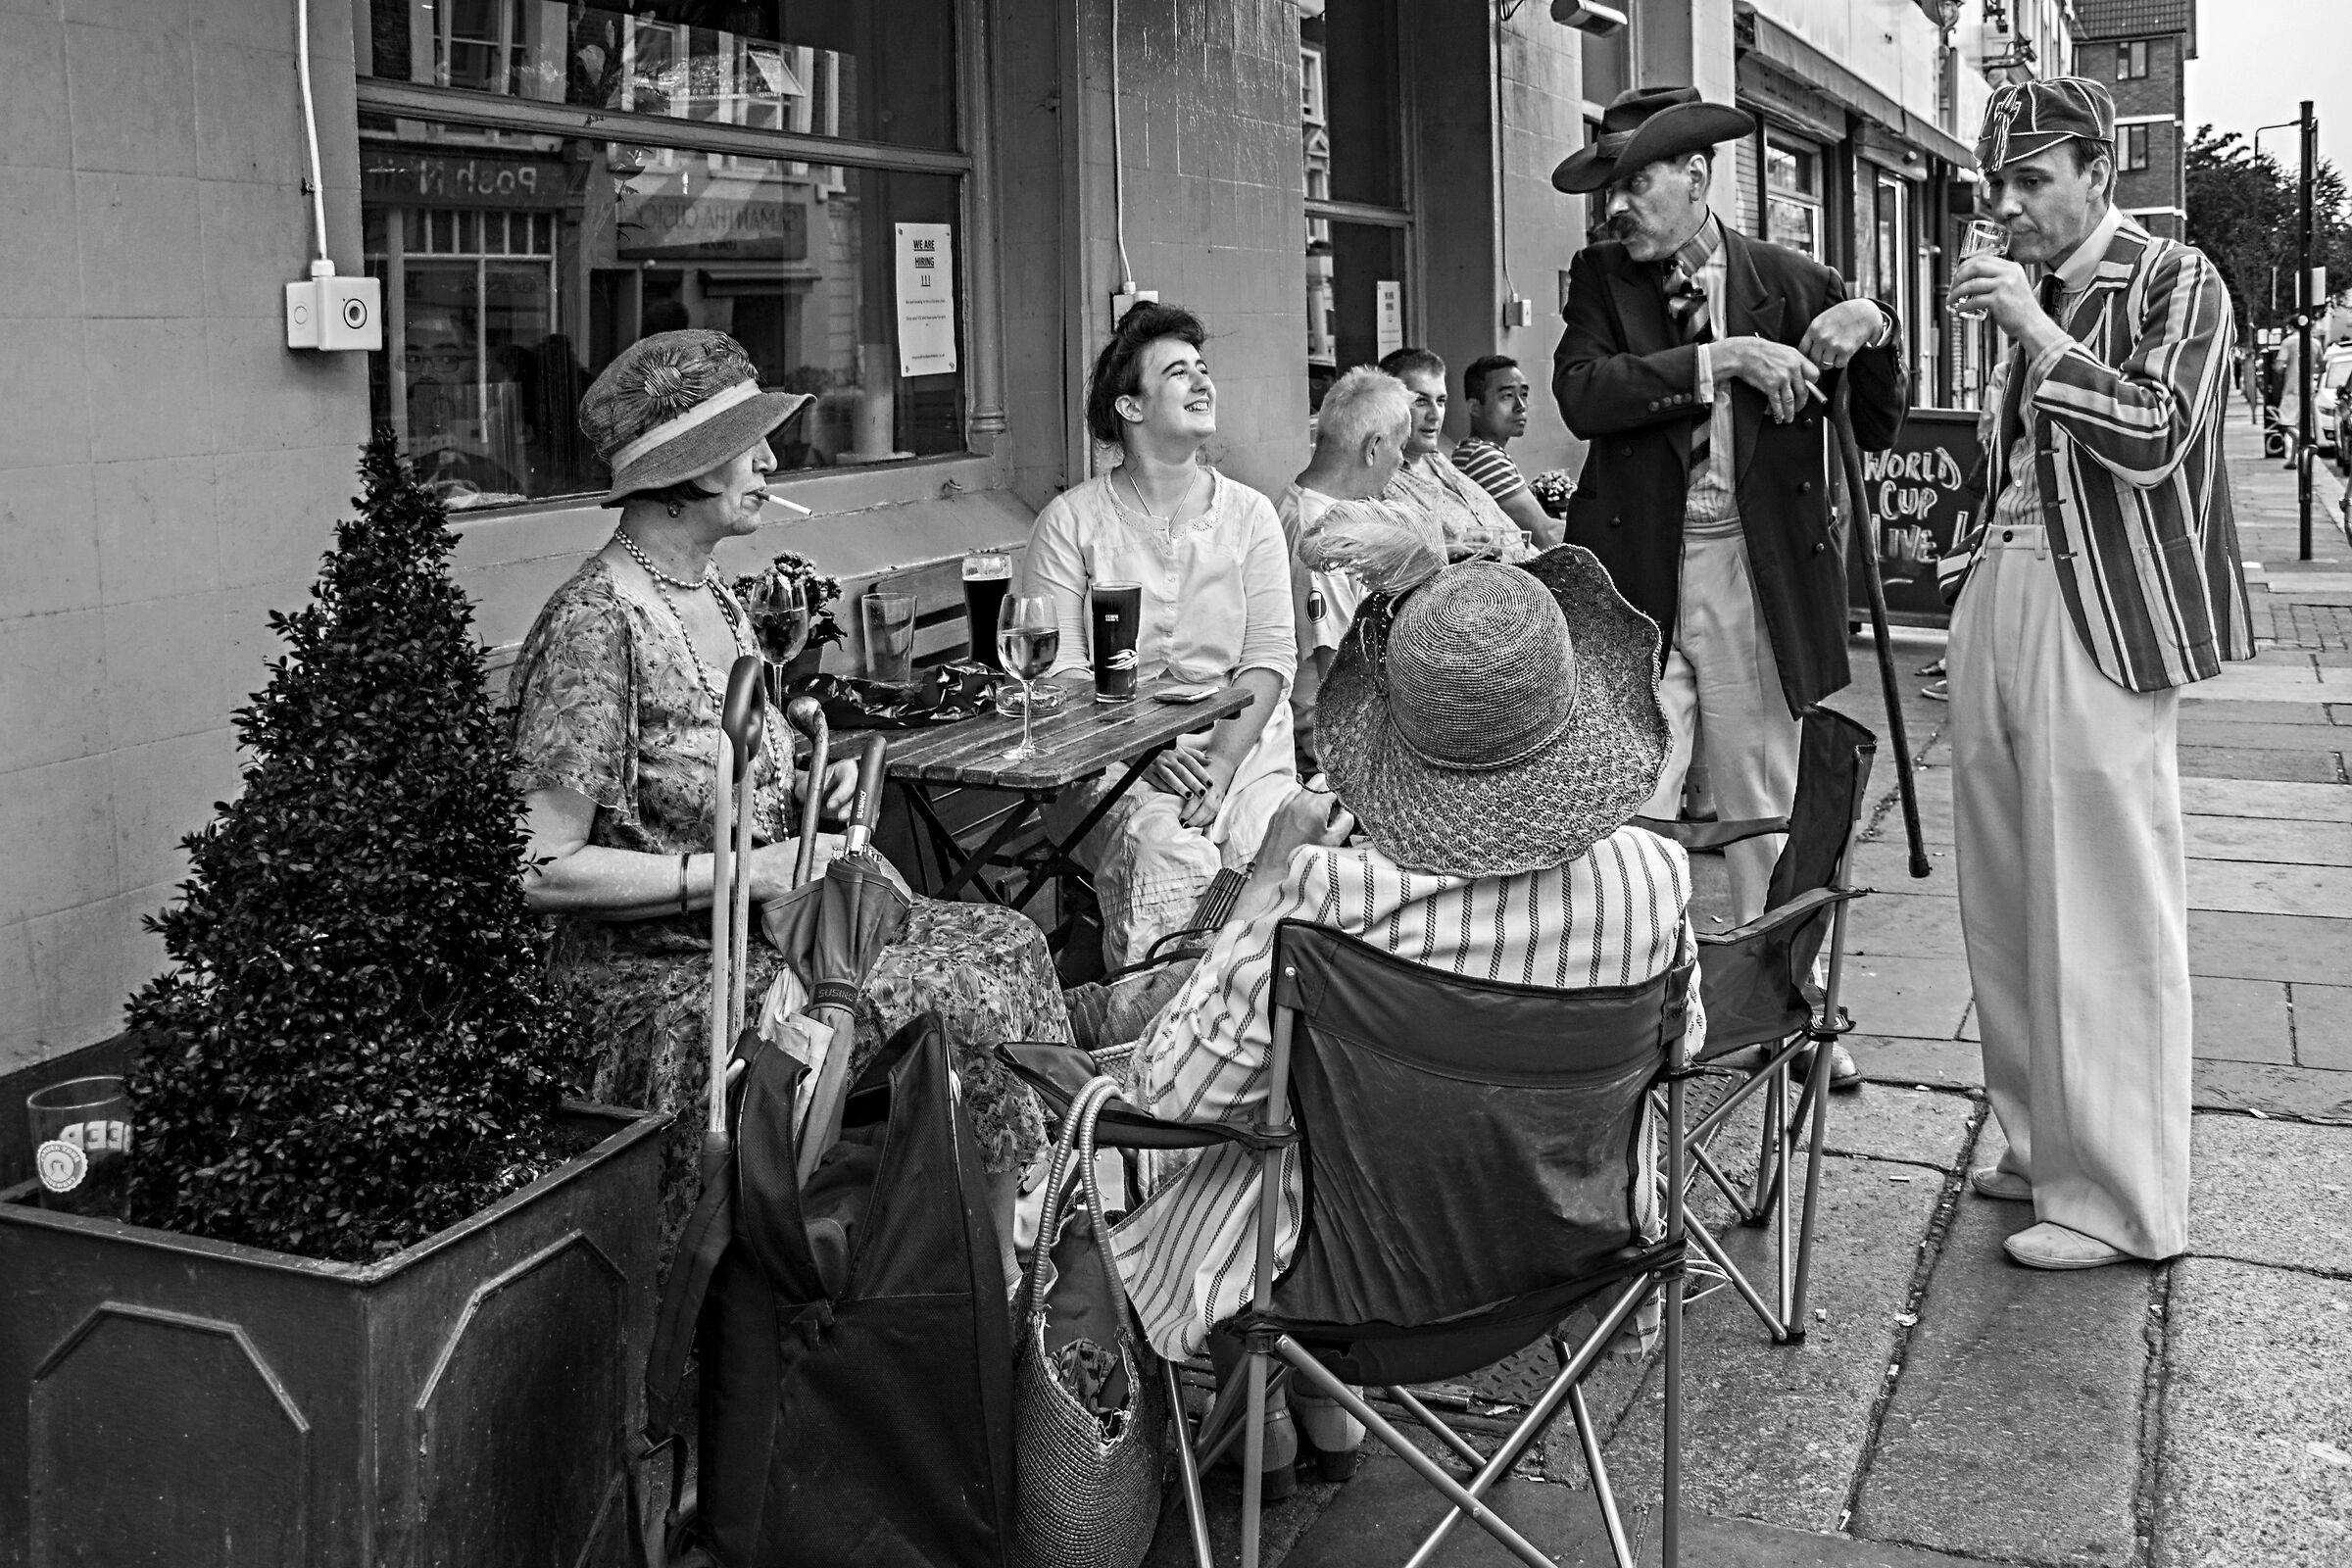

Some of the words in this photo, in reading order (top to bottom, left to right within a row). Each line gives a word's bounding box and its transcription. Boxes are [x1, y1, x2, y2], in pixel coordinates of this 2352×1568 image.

[912, 239, 923, 249] WE
[924, 239, 935, 249] ARE
[914, 257, 935, 267] HIRING
[1864, 447, 1962, 491] WORLD
[1880, 480, 1937, 520] CUP
[817, 988, 855, 1003] SUSINO
